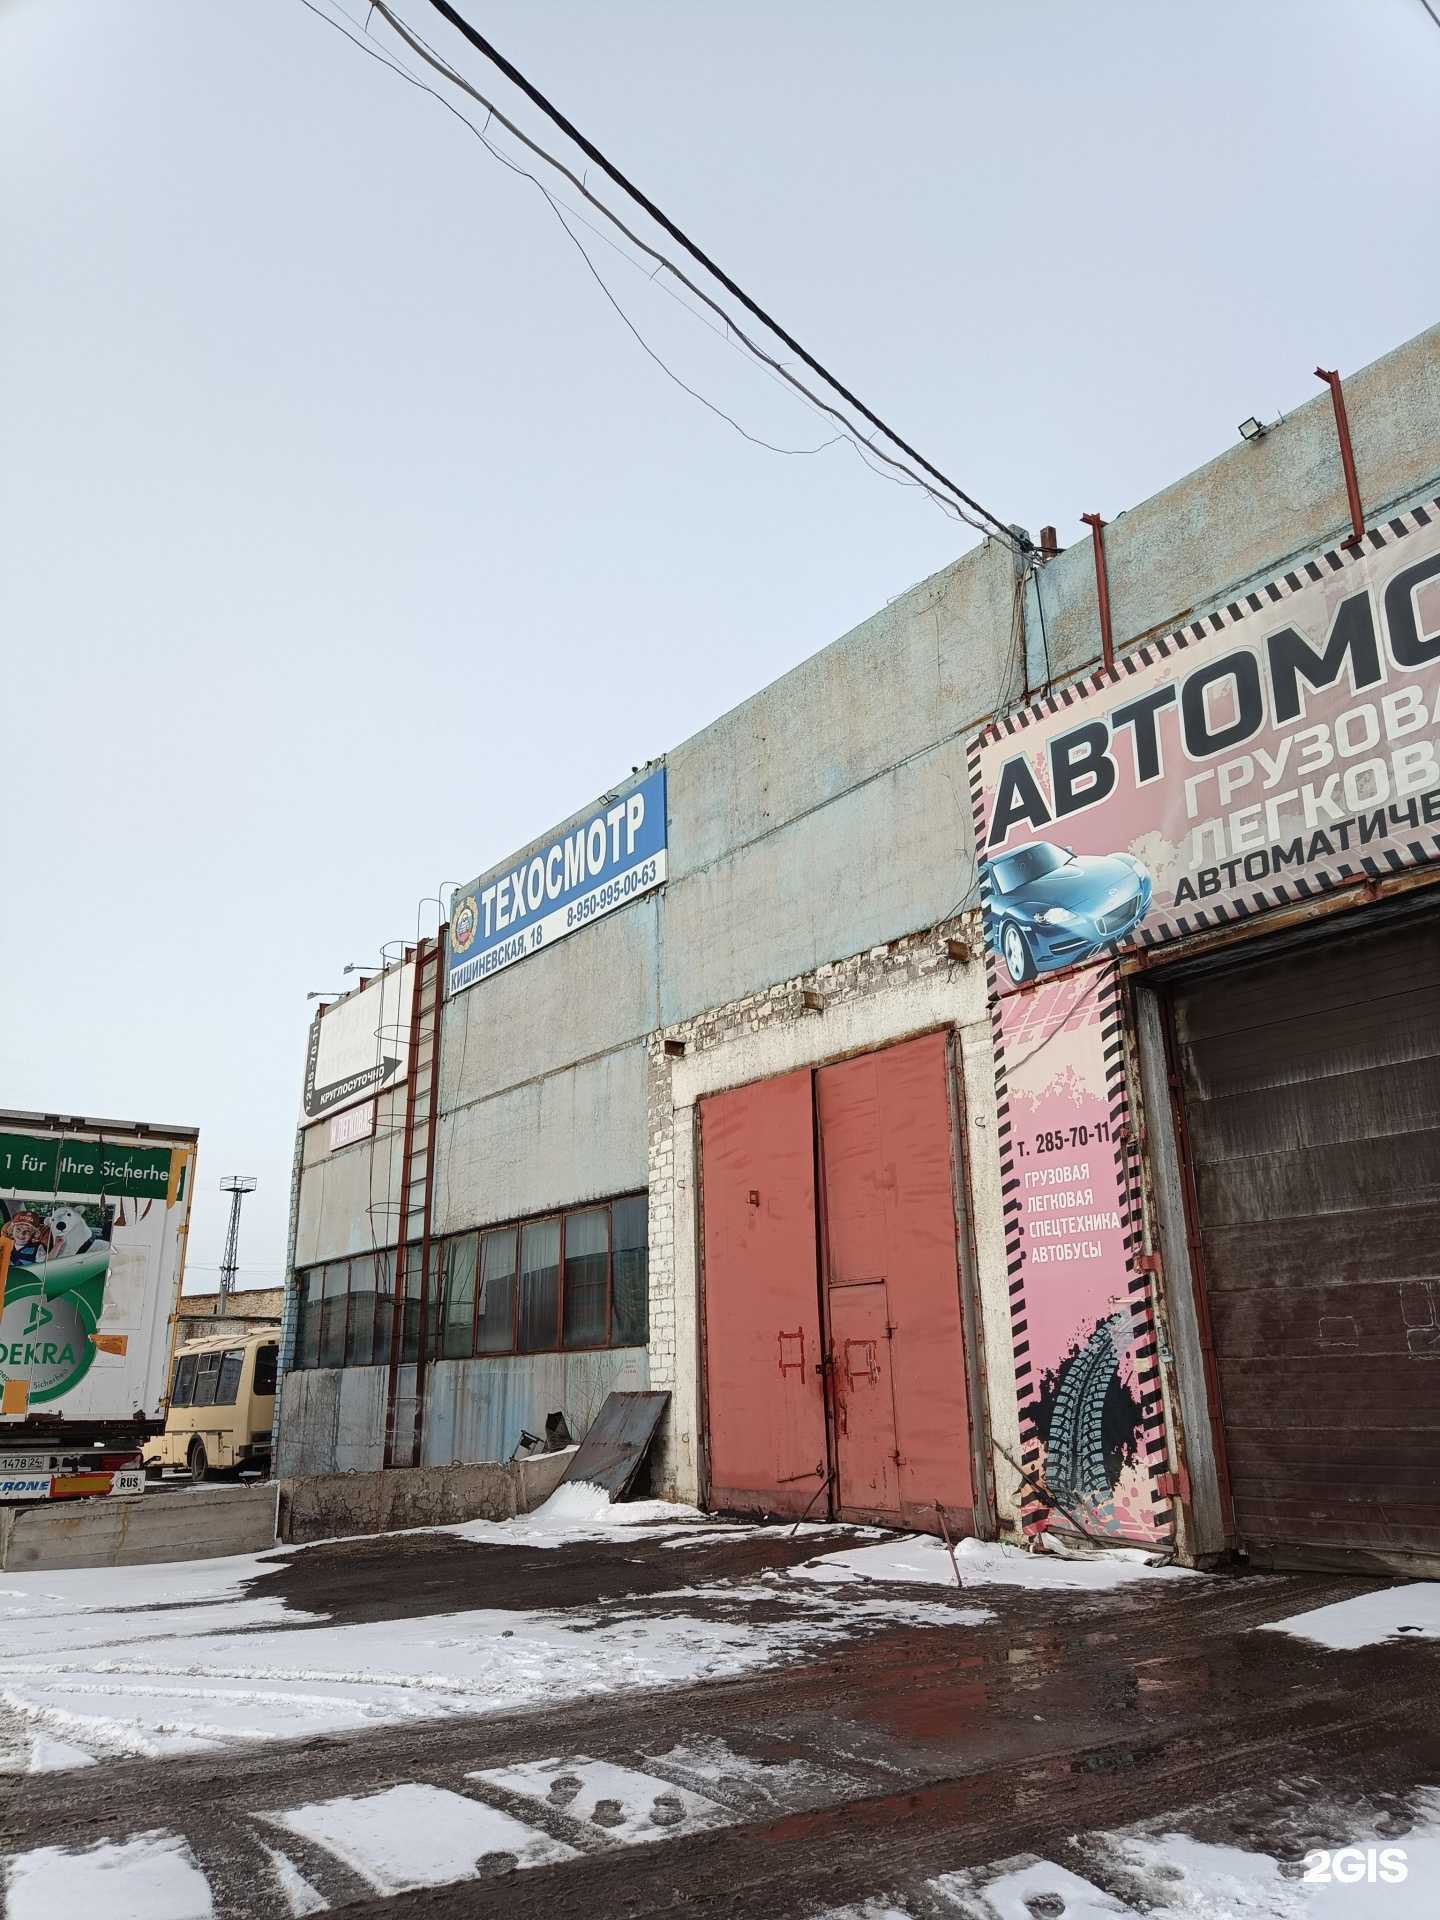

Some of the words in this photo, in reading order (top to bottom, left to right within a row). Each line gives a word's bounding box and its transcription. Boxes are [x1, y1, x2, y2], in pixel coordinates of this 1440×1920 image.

[1184, 685, 1440, 818] ГРУЗОВ
[481, 792, 645, 938] ТЕХОСМОТР
[451, 938, 527, 991] КИШИНЕВСКАЯ,
[530, 925, 543, 946] 18
[566, 860, 657, 928] 8-950-995-00-63
[320, 1065, 385, 1105] КРУГЛОСУТОЧНО
[1035, 1121, 1110, 1154] 285-70-11
[5, 1154, 12, 1169] 1
[21, 1154, 47, 1172] für
[61, 1157, 95, 1175] Ihre
[1024, 1163, 1090, 1188] ГРУЗОВАЯ
[1027, 1189, 1094, 1213] ЛЕГКОВАЯ
[1029, 1212, 1121, 1238] СПЕЦТЕХНИКА
[1031, 1241, 1103, 1264] АВТОБУСЫ
[2, 1458, 27, 1468] 1478
[0, 1481, 49, 1491] RONE
[120, 1477, 138, 1488] RUS
